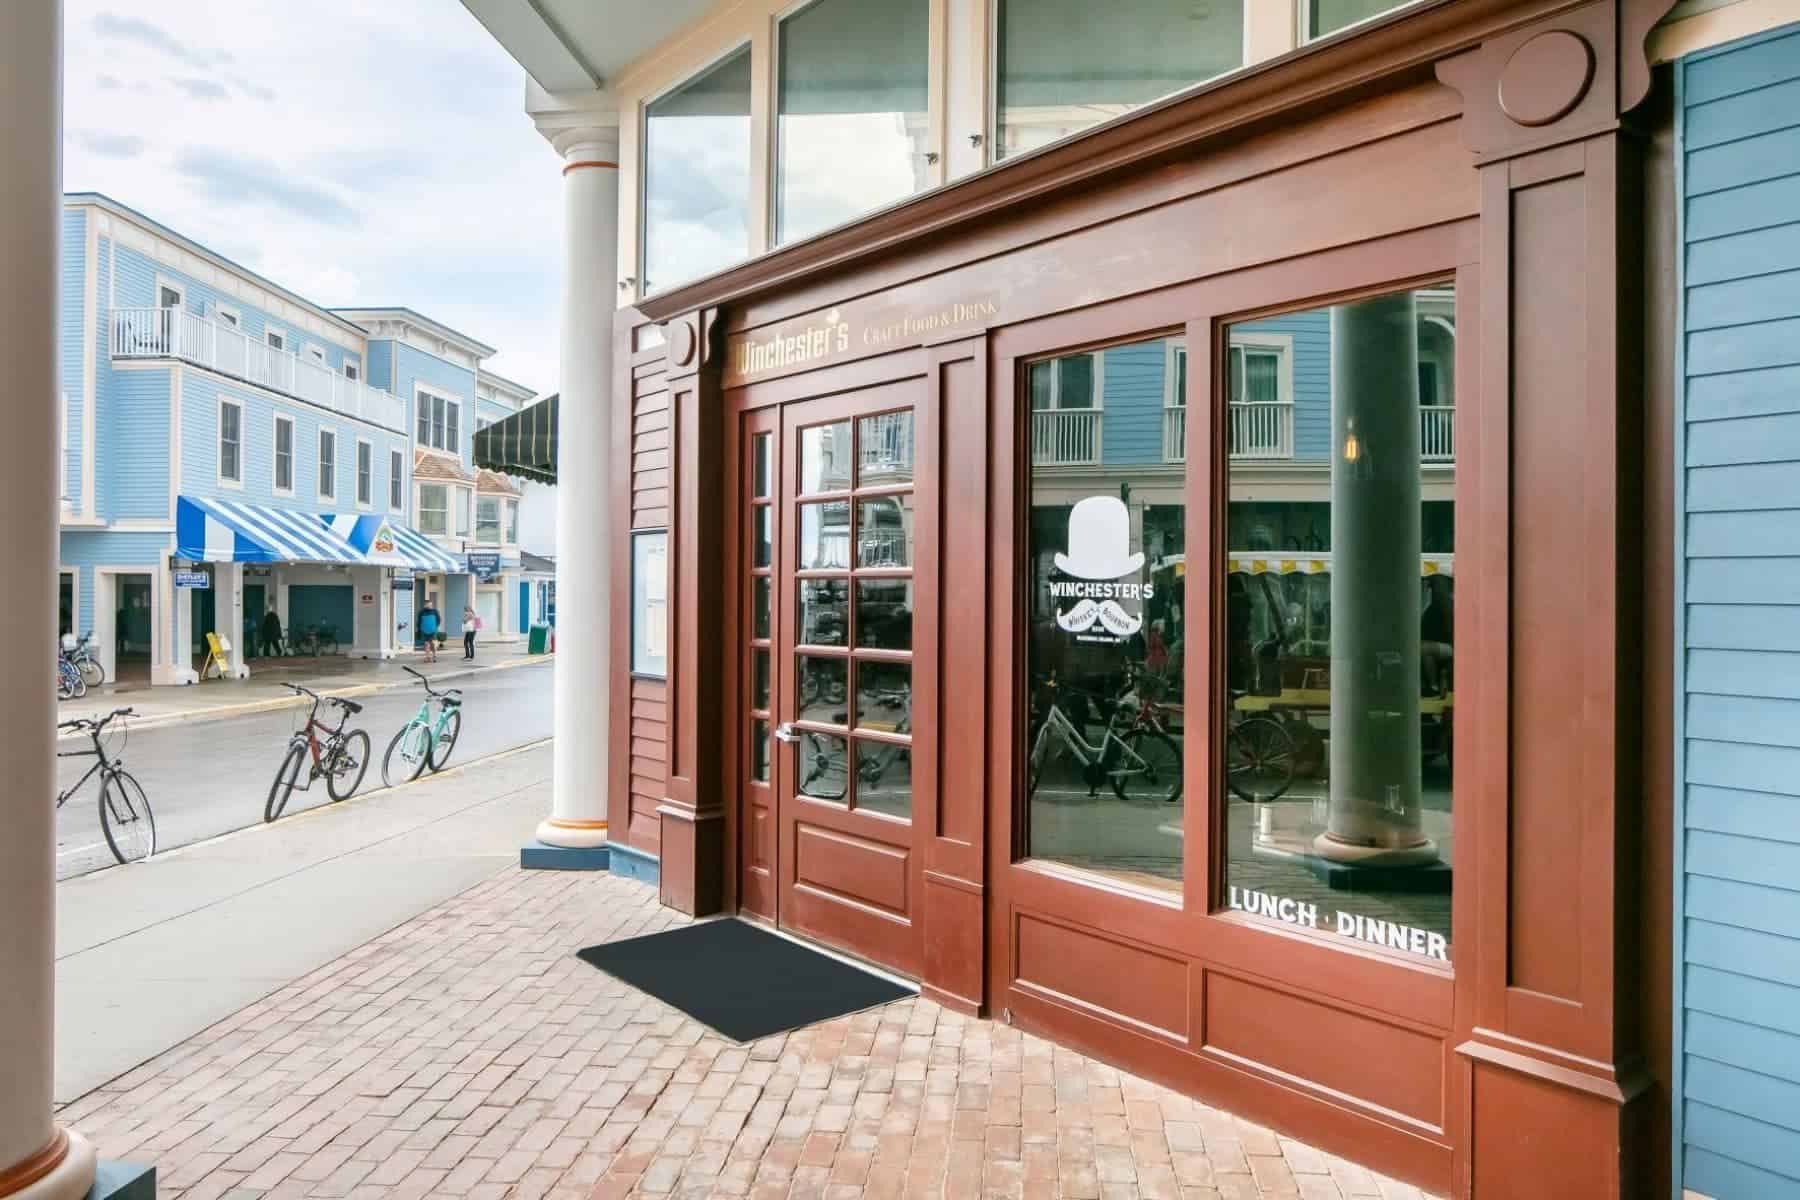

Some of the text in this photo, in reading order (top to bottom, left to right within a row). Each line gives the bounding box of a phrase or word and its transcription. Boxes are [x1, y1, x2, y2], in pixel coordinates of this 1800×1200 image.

[735, 318, 849, 375] Winchester's
[1049, 581, 1154, 600] WINCHESTER'S
[1229, 885, 1448, 961] LUNCH DINNER
